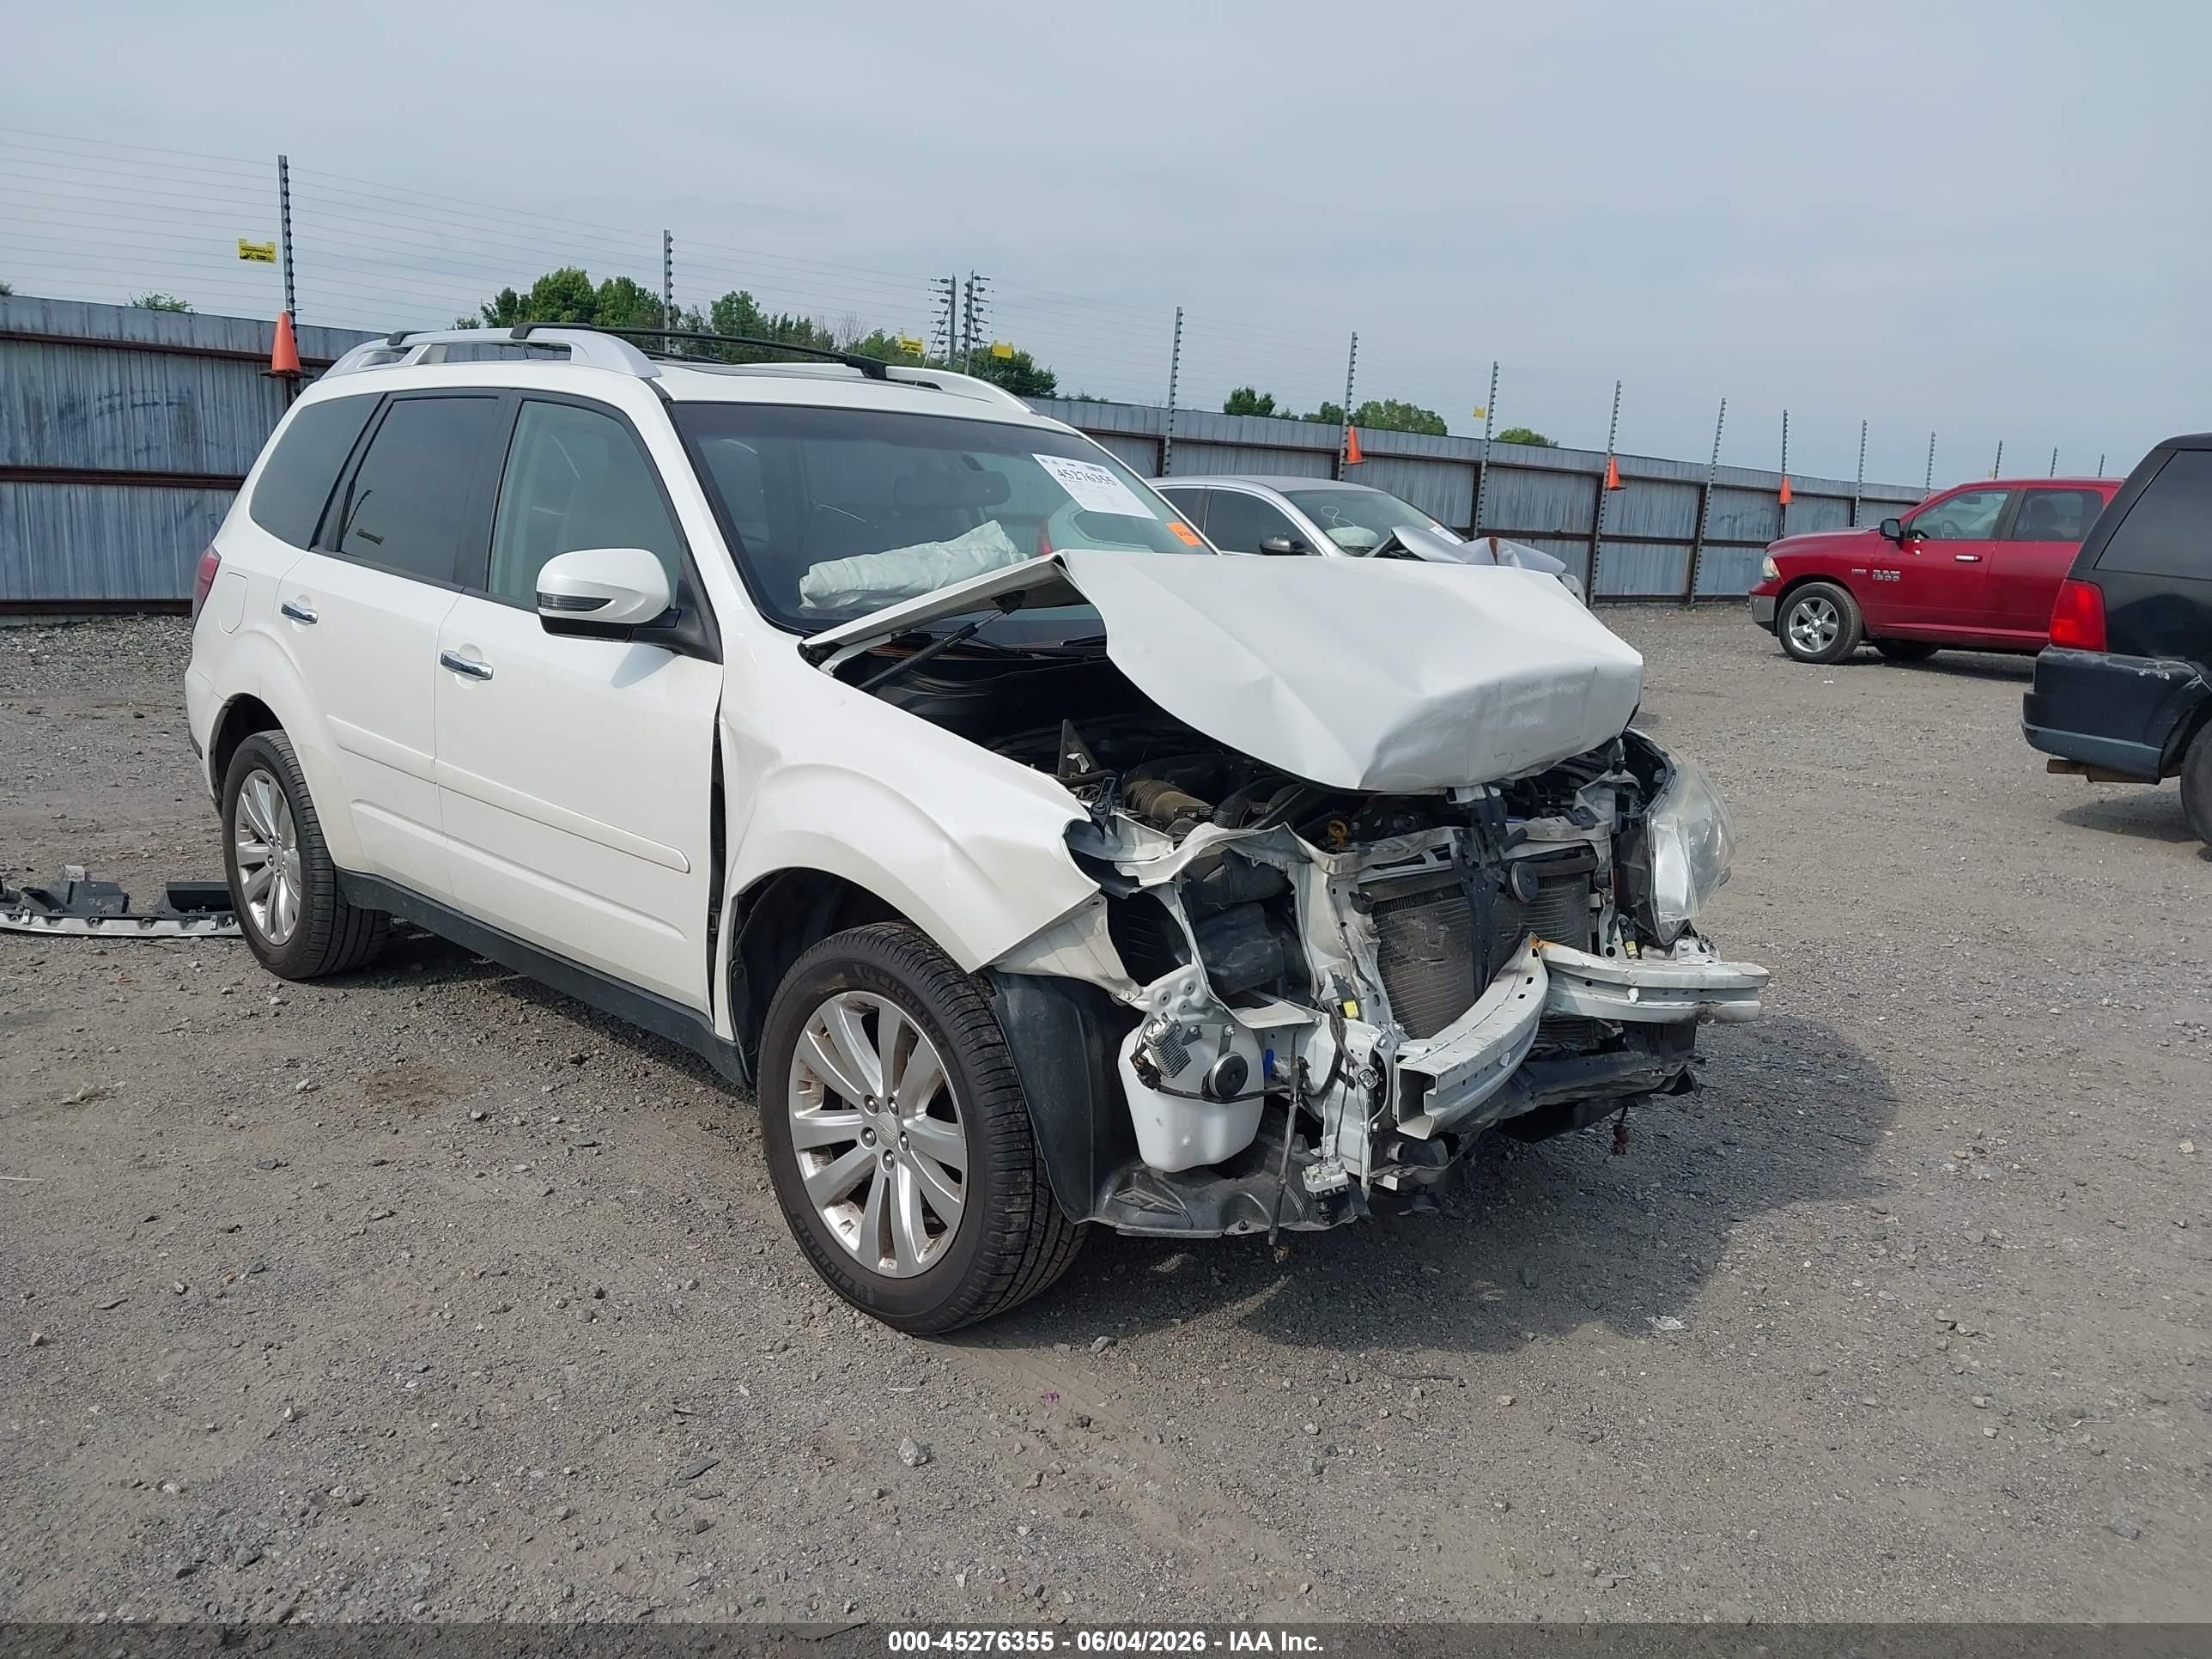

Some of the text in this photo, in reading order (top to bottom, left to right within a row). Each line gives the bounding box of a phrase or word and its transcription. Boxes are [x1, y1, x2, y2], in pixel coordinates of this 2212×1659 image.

[1057, 470, 1117, 487] 45276355
[878, 974, 946, 1046] MICHELIN
[791, 1212, 857, 1290] MICHELIN
